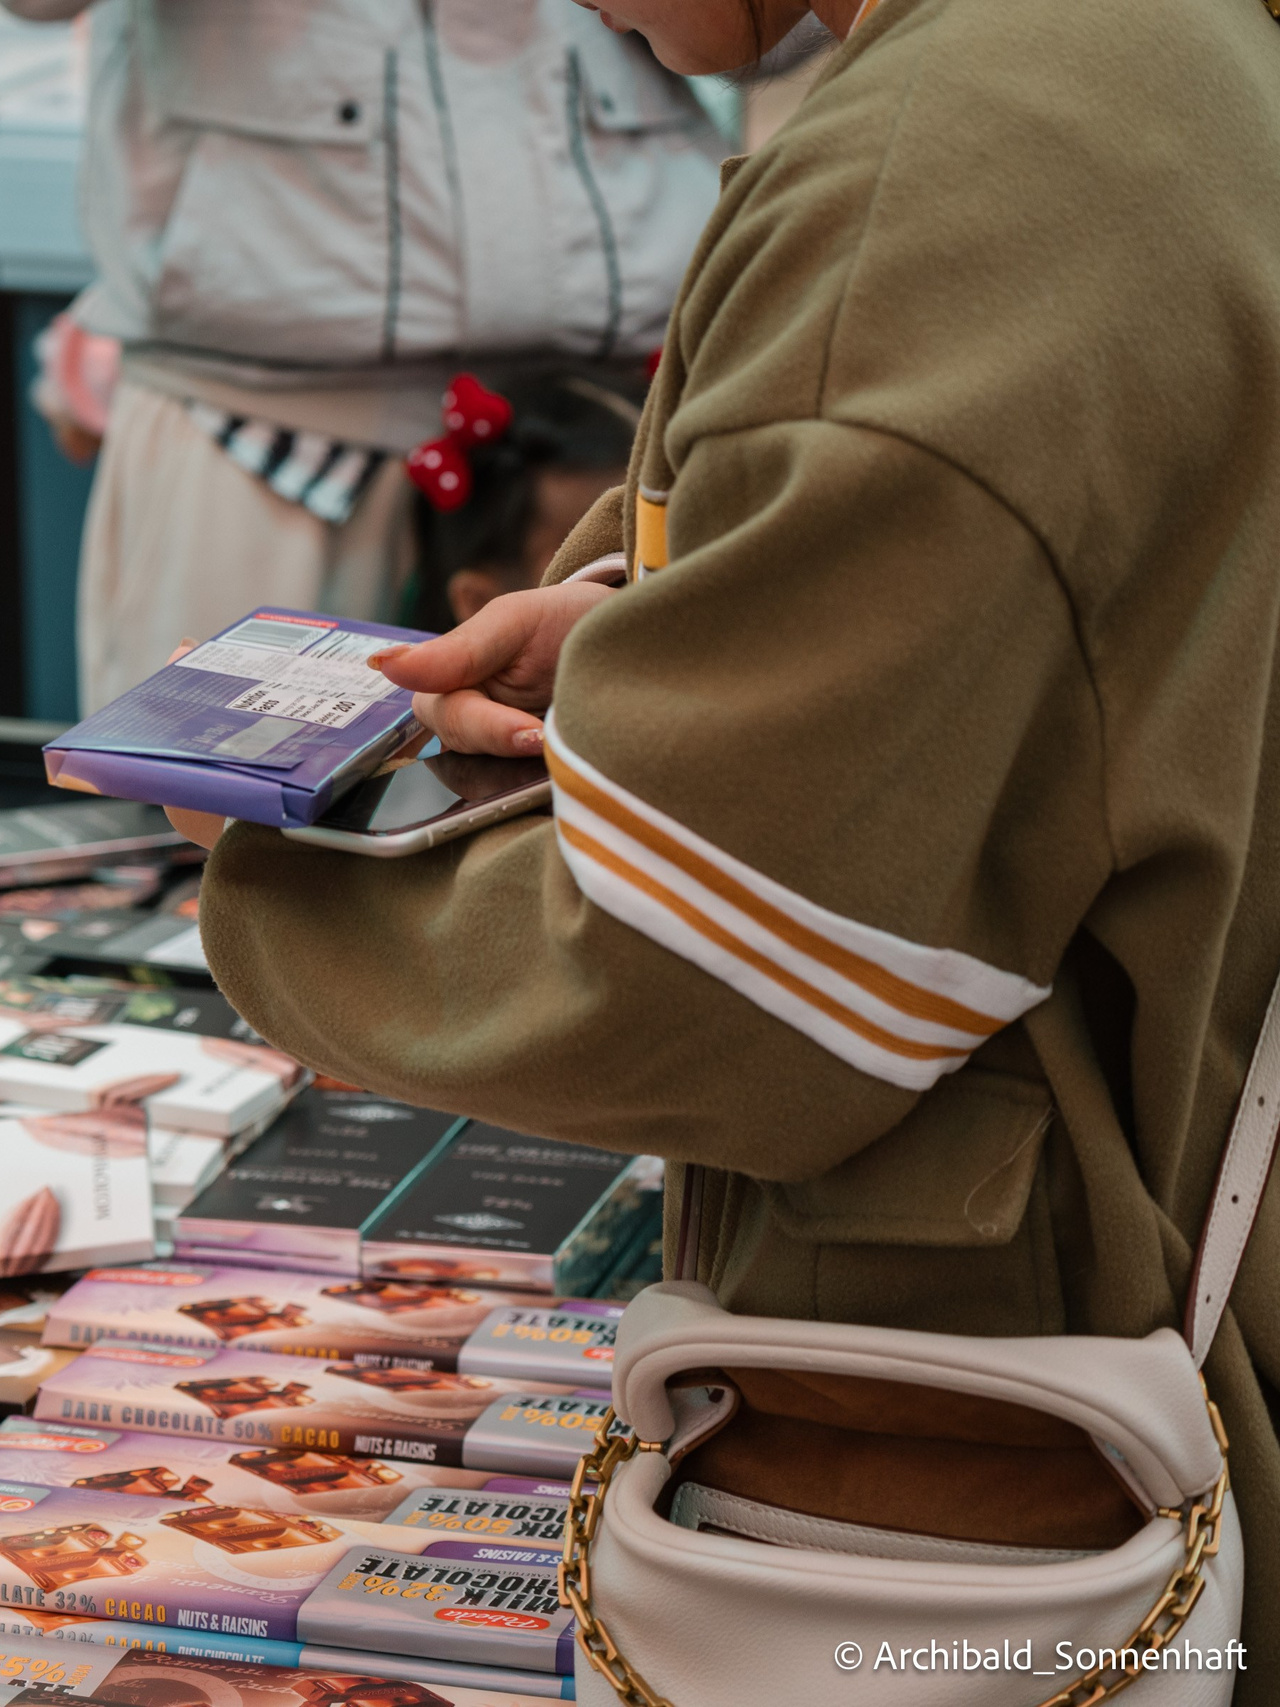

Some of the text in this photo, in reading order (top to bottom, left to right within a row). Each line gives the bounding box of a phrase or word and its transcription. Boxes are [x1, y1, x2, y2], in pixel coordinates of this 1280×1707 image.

[61, 1400, 437, 1461] DARK CHOCOLATE 50% CACAO NUTS & RAISINS
[428, 1512, 514, 1534] 50%
[474, 1548, 550, 1563] & RAISINS
[362, 1576, 560, 1616] MILK 32%
[55, 1590, 97, 1614] 32%
[105, 1598, 167, 1623] CACAO
[178, 1608, 208, 1628] NUTS
[210, 1614, 219, 1629] &
[221, 1615, 268, 1637] RAISINS
[443, 1609, 539, 1629] Pobeda
